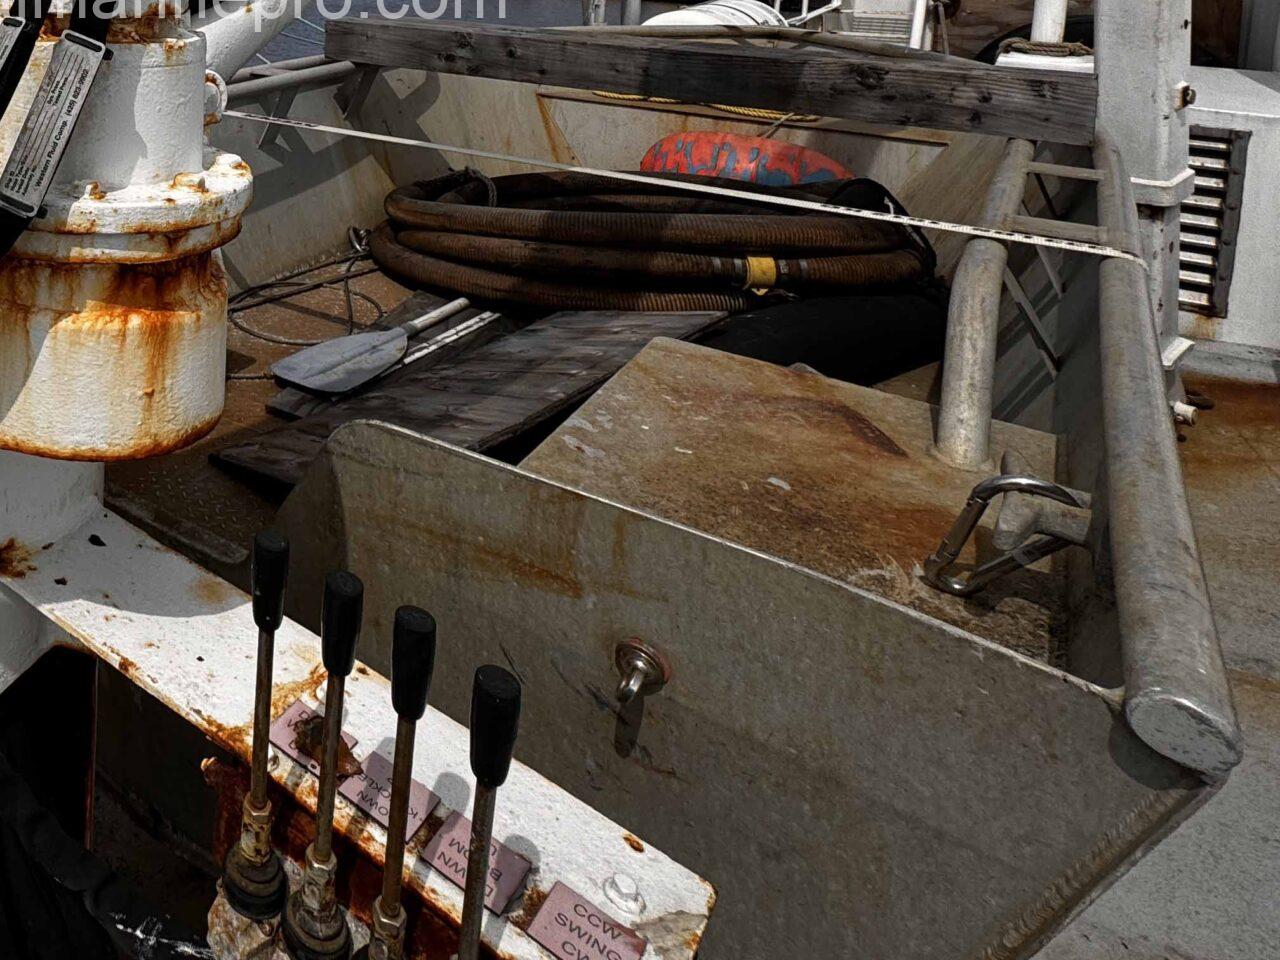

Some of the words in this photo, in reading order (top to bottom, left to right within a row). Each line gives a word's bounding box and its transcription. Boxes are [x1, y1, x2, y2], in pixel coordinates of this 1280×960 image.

[33, 158, 53, 188] Western
[46, 140, 60, 159] Fluid
[355, 788, 390, 817] OWN
[357, 771, 419, 819] KCKLE
[554, 912, 622, 960] SWING
[574, 903, 622, 940] CCW
